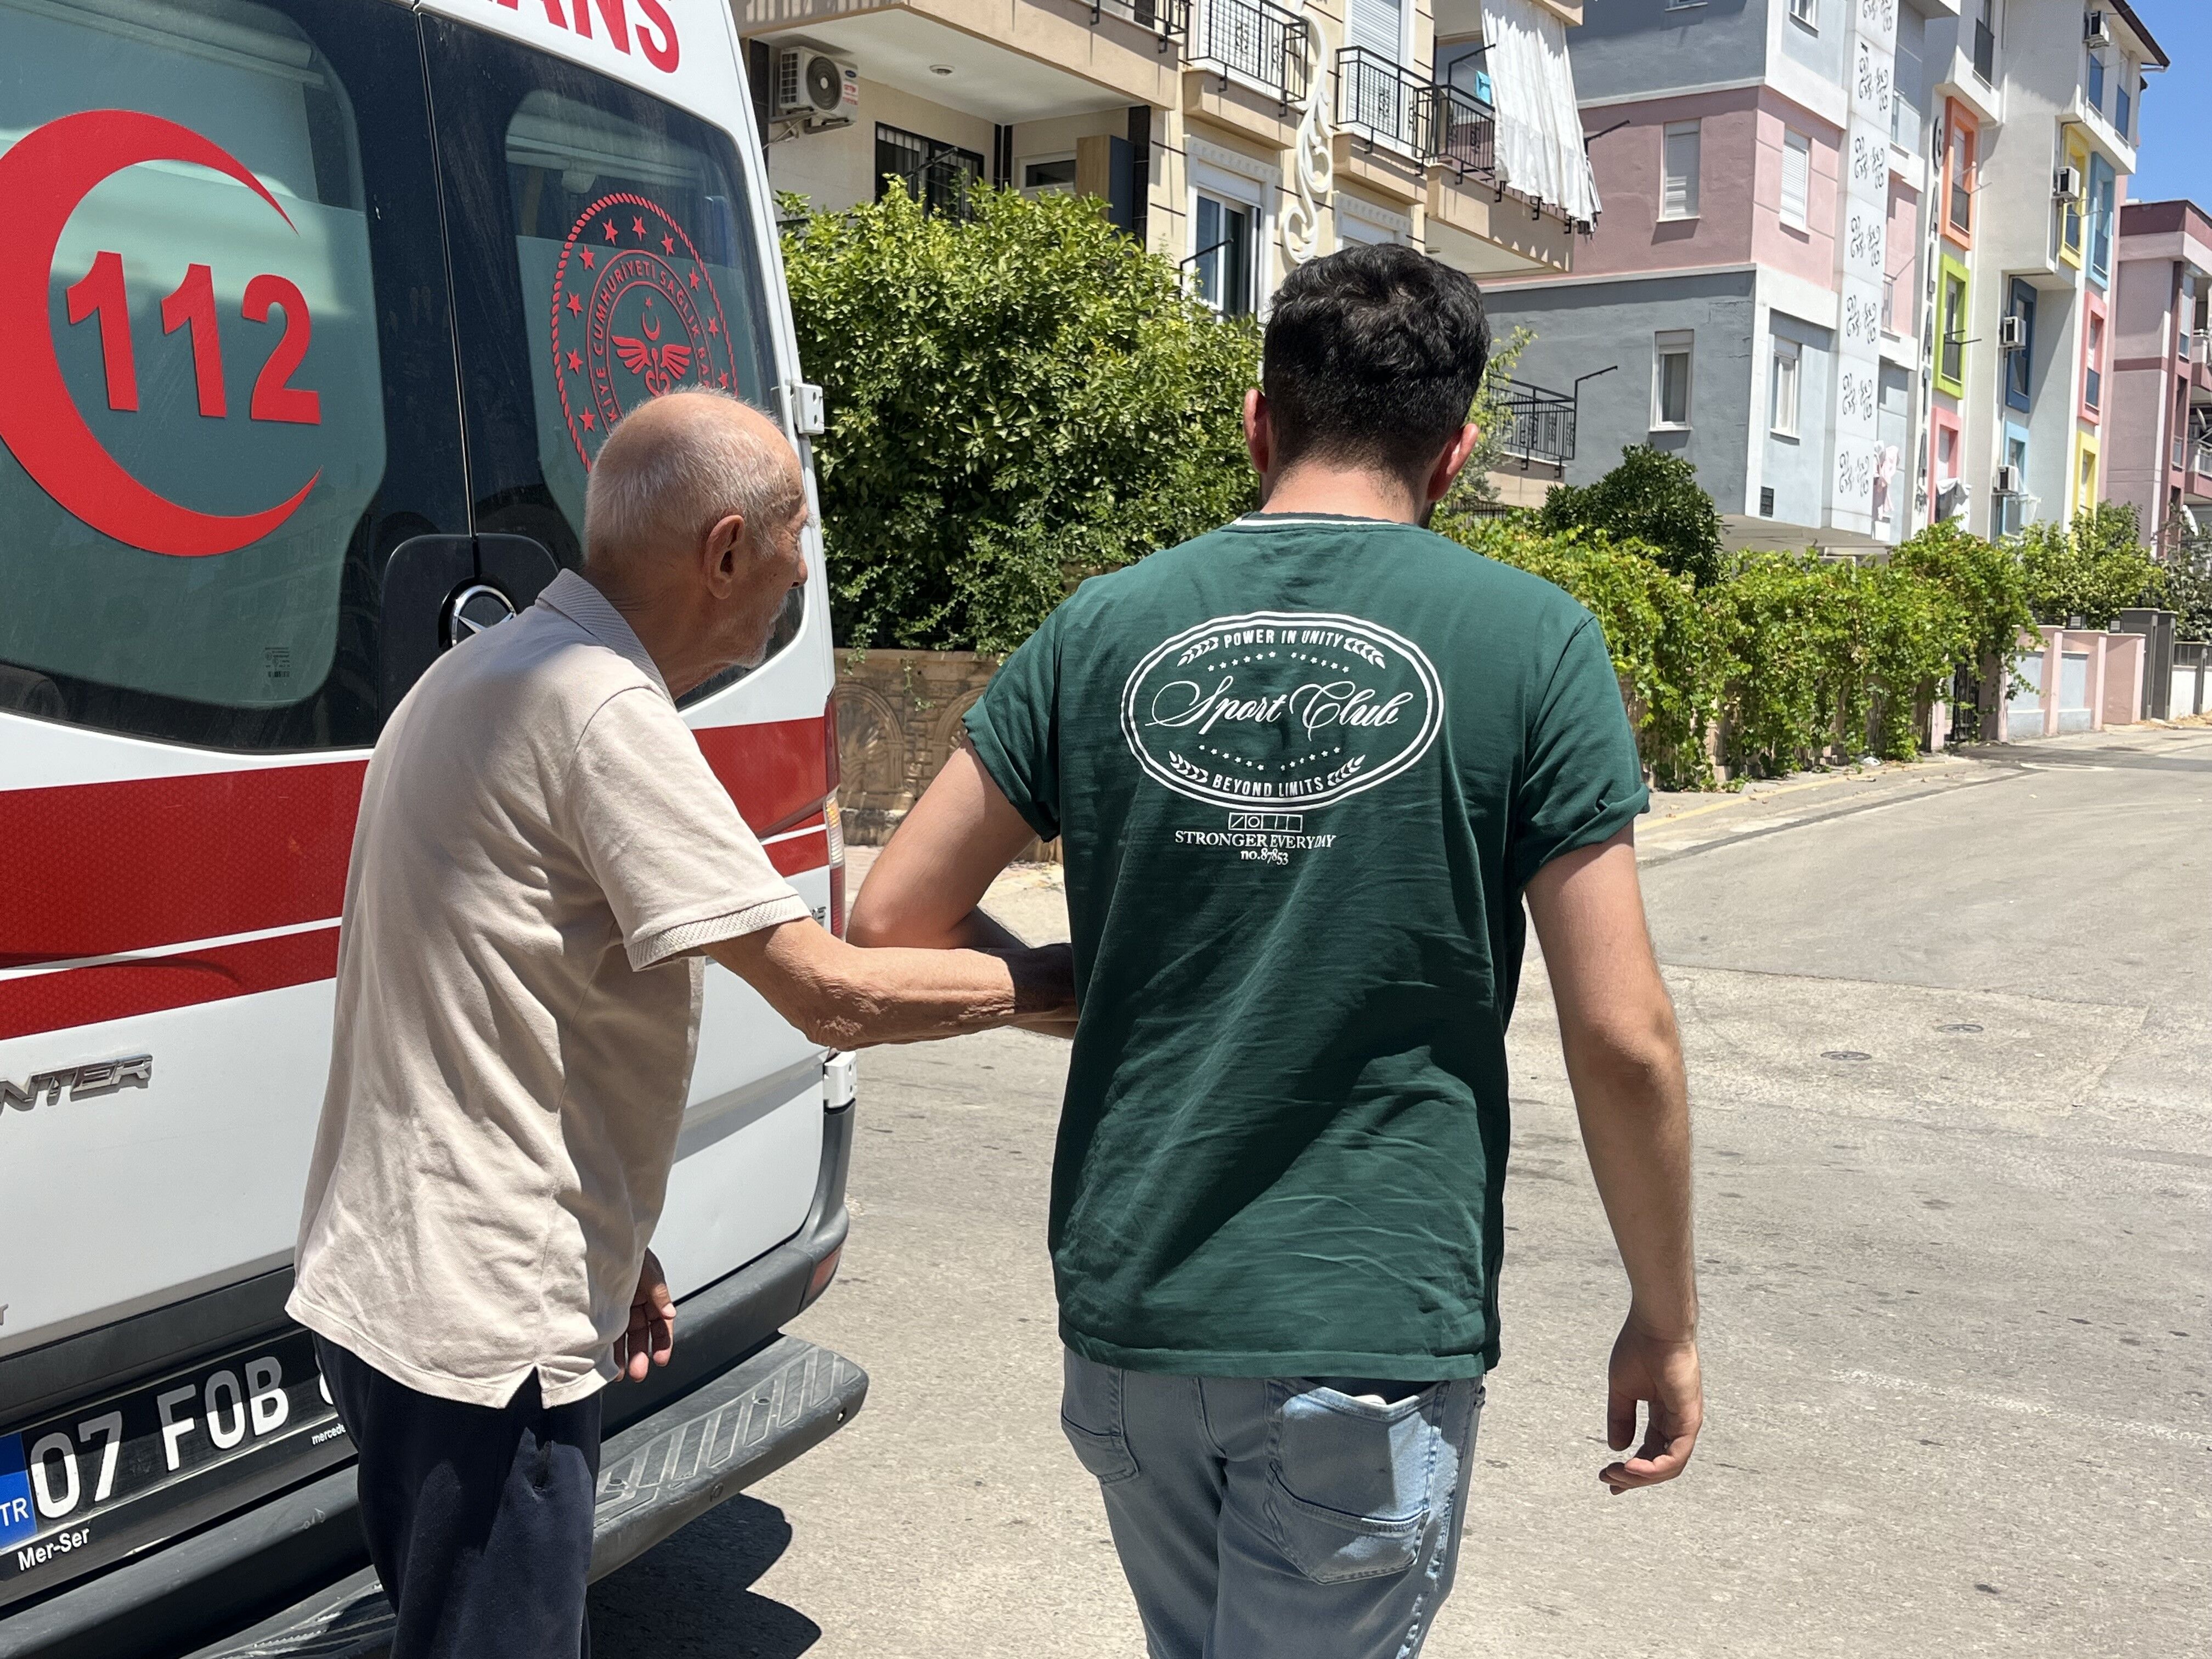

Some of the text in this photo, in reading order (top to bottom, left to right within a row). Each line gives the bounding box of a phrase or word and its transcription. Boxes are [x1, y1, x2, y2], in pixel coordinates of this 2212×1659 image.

[67, 250, 321, 424] 112
[1223, 629, 1344, 648] POWER IN UNITY
[1144, 675, 1414, 742] Sport Club
[1212, 774, 1324, 797] BEYOND LIMITS
[1175, 830, 1268, 848] STRONGER
[1240, 848, 1289, 866] no.87853
[30, 1410, 122, 1519] 07
[0, 1497, 29, 1527] TR
[17, 1528, 90, 1571] Mer-Ser
